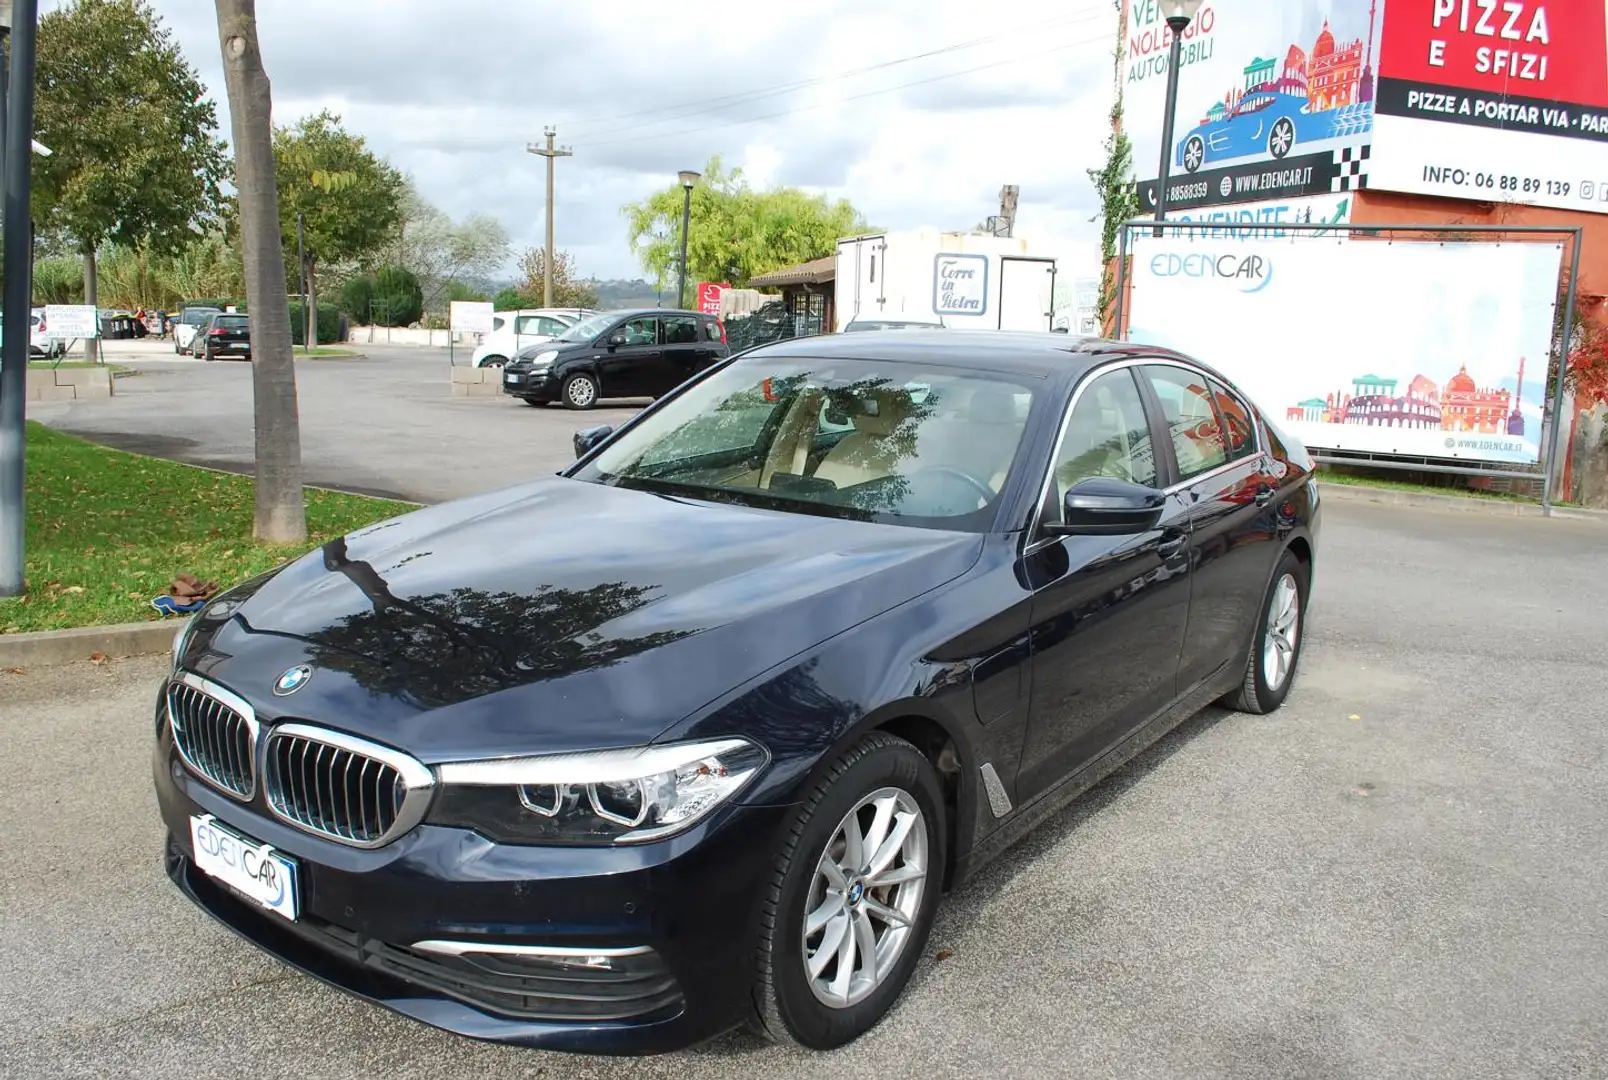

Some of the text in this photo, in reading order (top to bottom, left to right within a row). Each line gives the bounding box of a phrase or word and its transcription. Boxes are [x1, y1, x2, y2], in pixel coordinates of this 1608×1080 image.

[1129, 7, 1214, 60] NOLEGIO
[1432, 0, 1549, 44] PIZZA
[1429, 40, 1548, 81] E SFIZI
[1407, 90, 1455, 114] PIZZE
[1458, 97, 1471, 116] A
[1474, 99, 1539, 125] PORTAR
[1542, 108, 1569, 128] VIA
[1235, 167, 1313, 193] WWW.EDENCAR.IT
[1422, 165, 1571, 196] INFO: 06 88 89 139
[1200, 206, 1289, 239] VENDITE
[1150, 253, 1263, 279] EDENCAR
